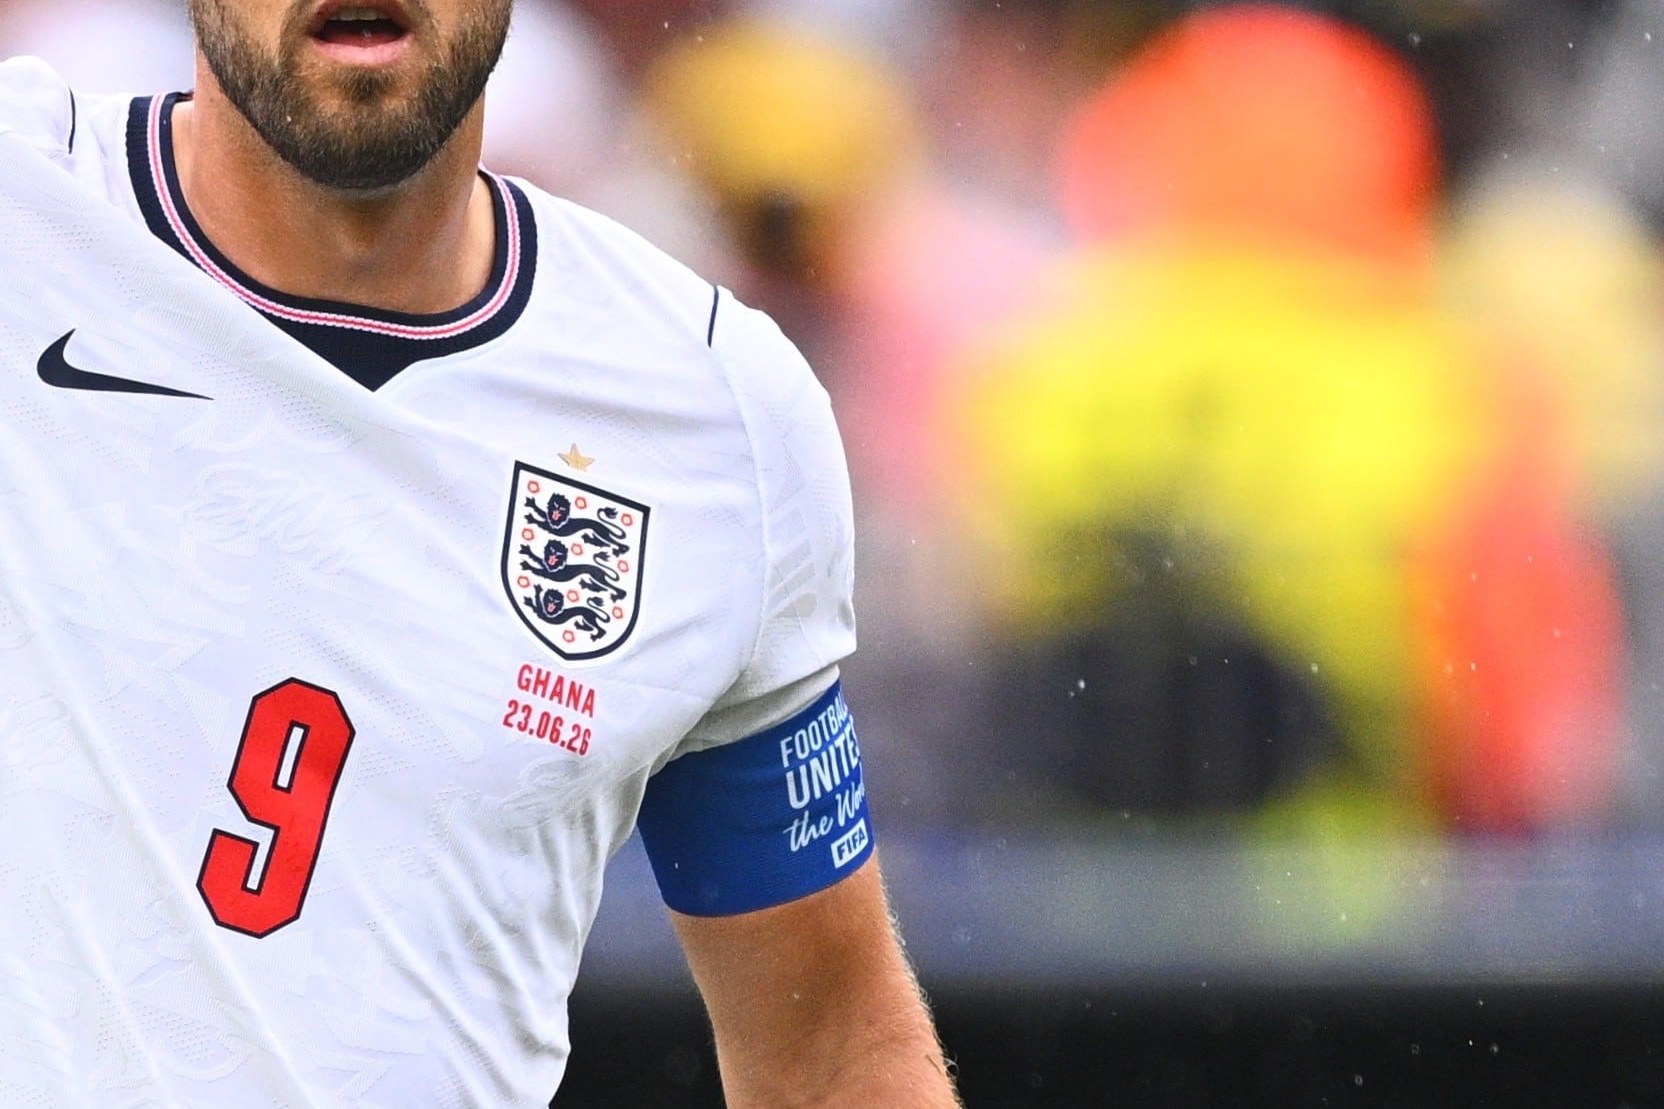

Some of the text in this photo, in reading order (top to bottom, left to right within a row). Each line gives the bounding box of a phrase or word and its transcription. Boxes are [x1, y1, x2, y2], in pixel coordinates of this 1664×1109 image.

[518, 664, 596, 718] GHANA
[503, 699, 591, 756] 23.06.26
[780, 689, 848, 768] FOOTBAL
[196, 677, 356, 939] 9
[783, 810, 834, 853] the
[835, 826, 867, 864] FIFA
